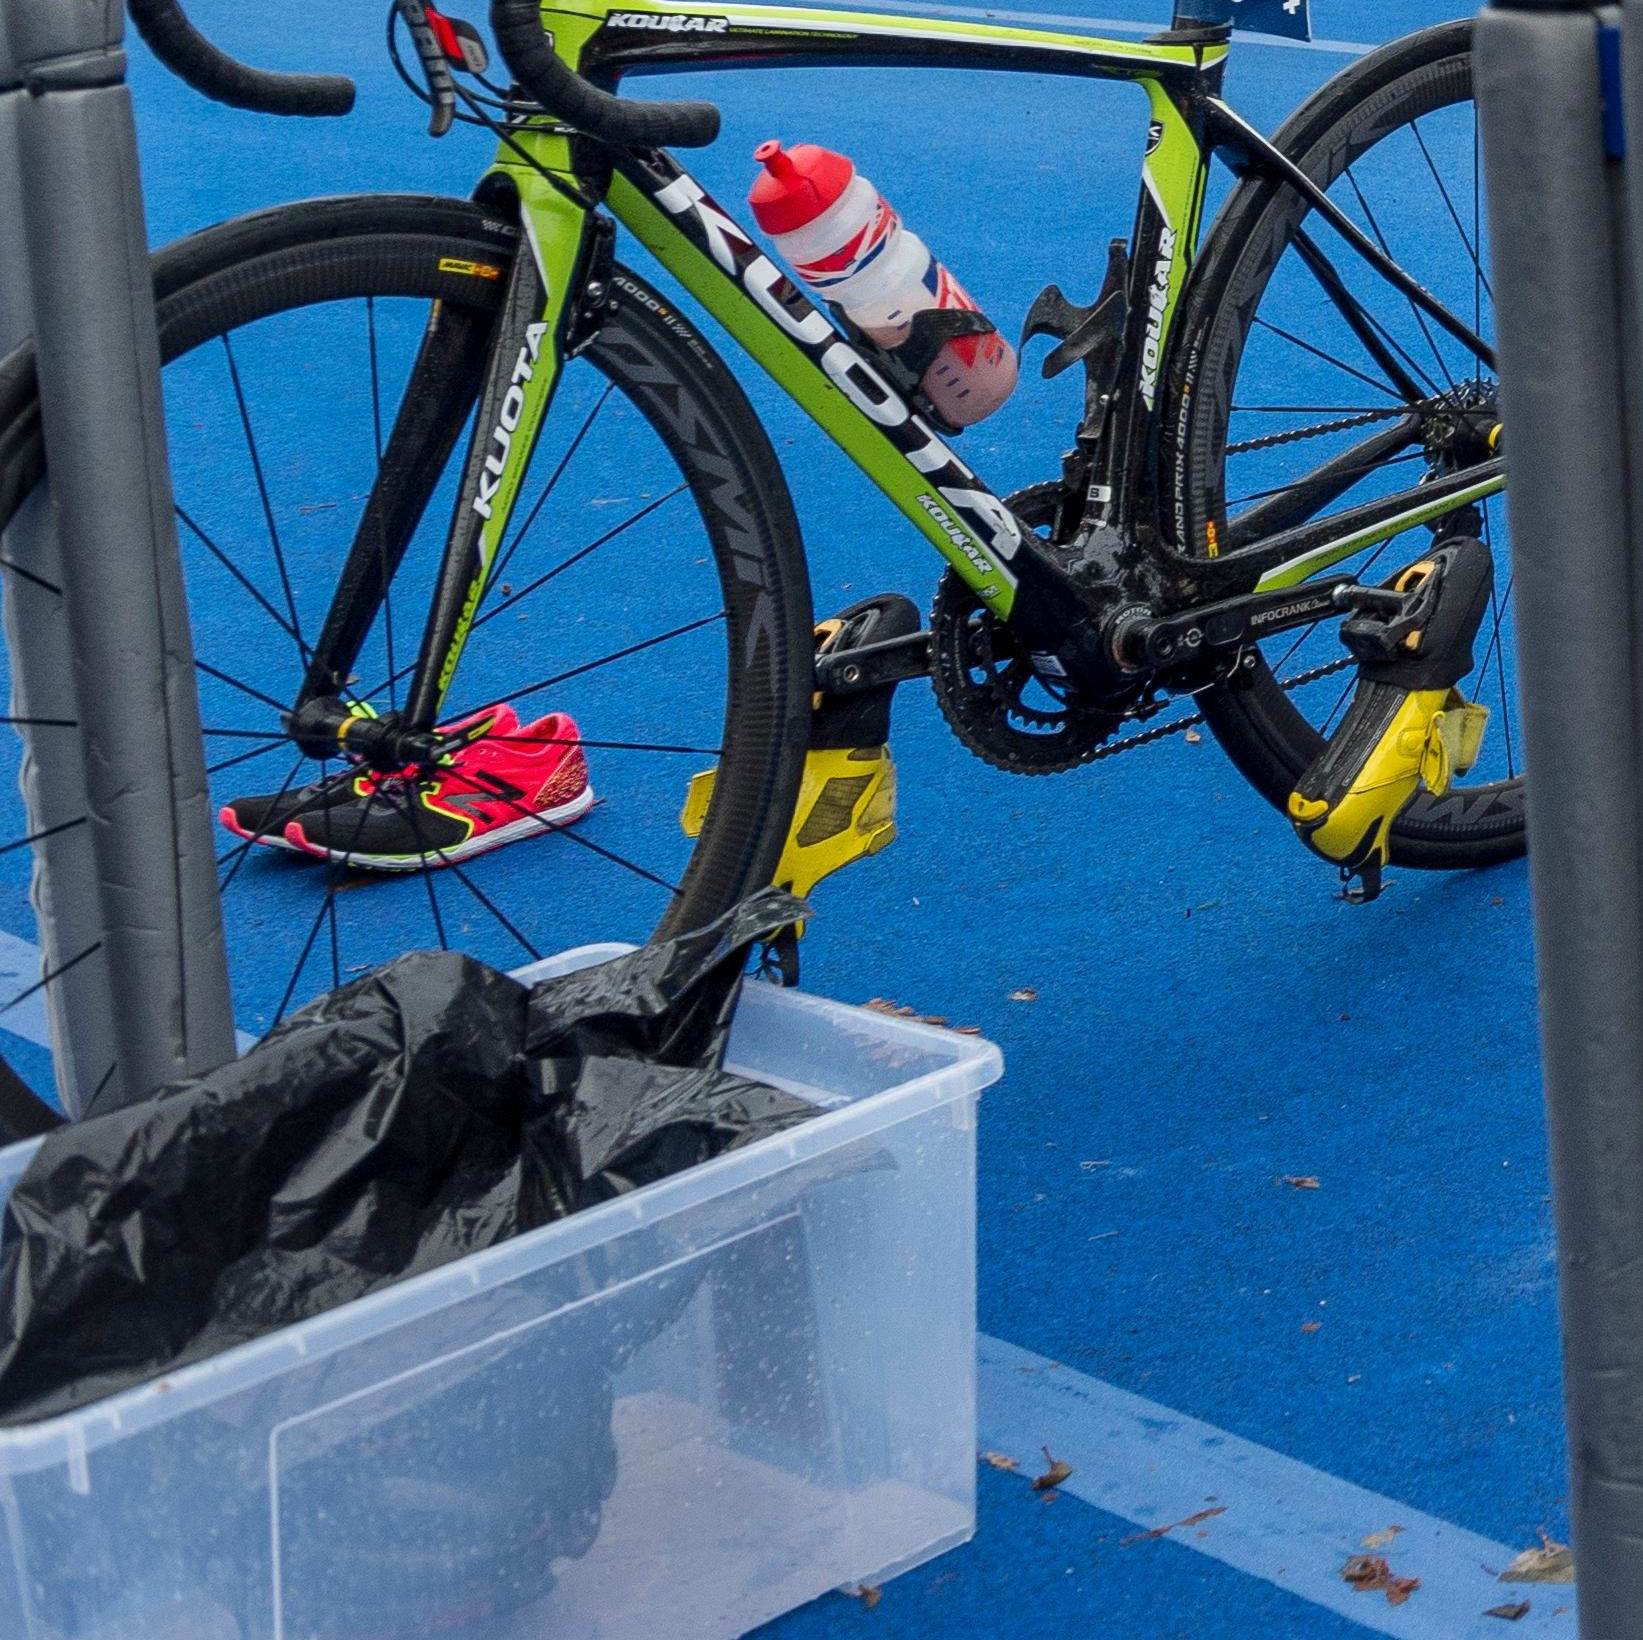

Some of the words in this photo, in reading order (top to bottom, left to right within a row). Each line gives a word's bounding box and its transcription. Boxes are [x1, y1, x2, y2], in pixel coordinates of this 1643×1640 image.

[611, 275, 660, 312] 4000
[654, 172, 1021, 561] KUOTA
[472, 321, 549, 521] KUOTA
[1177, 395, 1190, 450] 4000
[1174, 451, 1185, 504] PRIX
[1114, 605, 1153, 626] ROTOR
[1250, 601, 1312, 627] INFOCRANK
